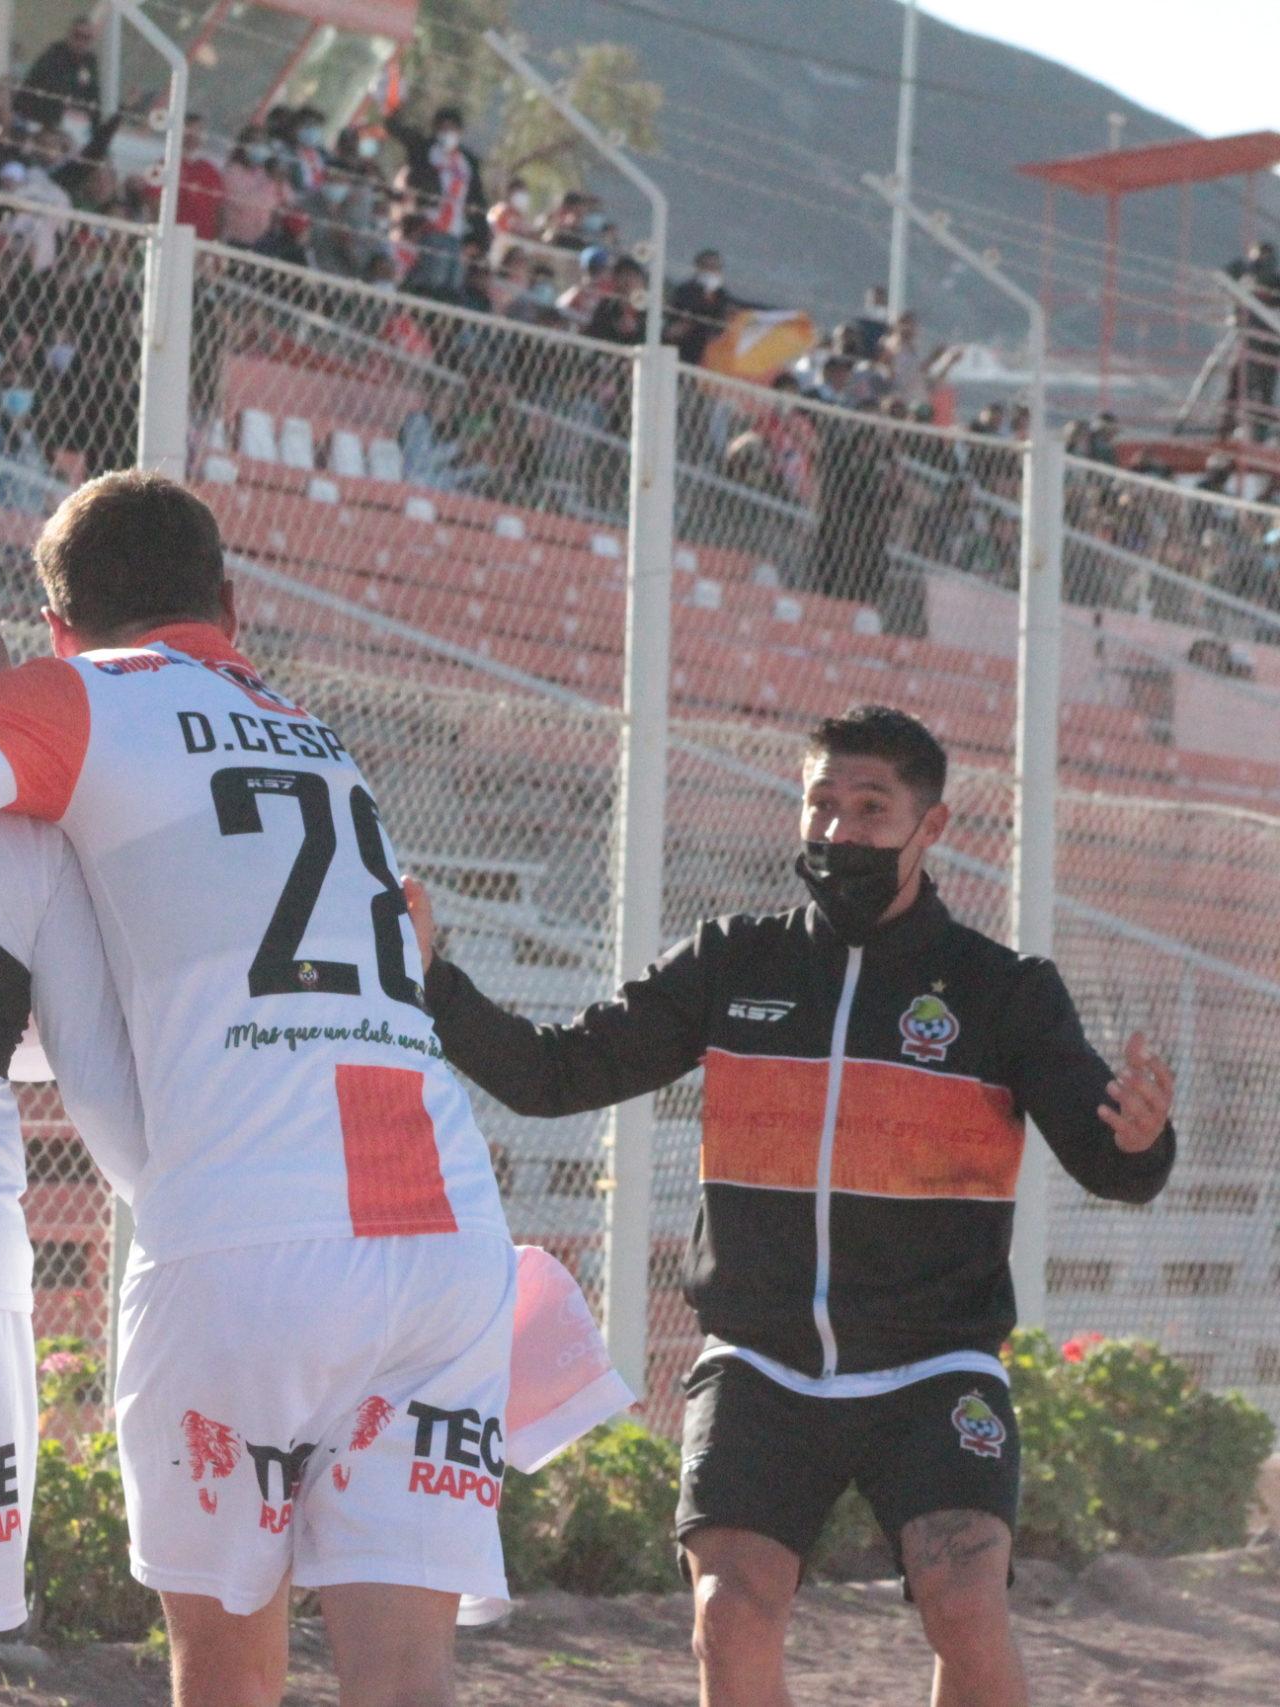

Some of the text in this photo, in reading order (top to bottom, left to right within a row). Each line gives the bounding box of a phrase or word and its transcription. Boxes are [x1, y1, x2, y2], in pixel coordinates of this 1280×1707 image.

[176, 711, 346, 762] D.CESP
[210, 766, 425, 1008] 28
[727, 999, 797, 1022] KS7
[406, 1399, 505, 1479] TEC
